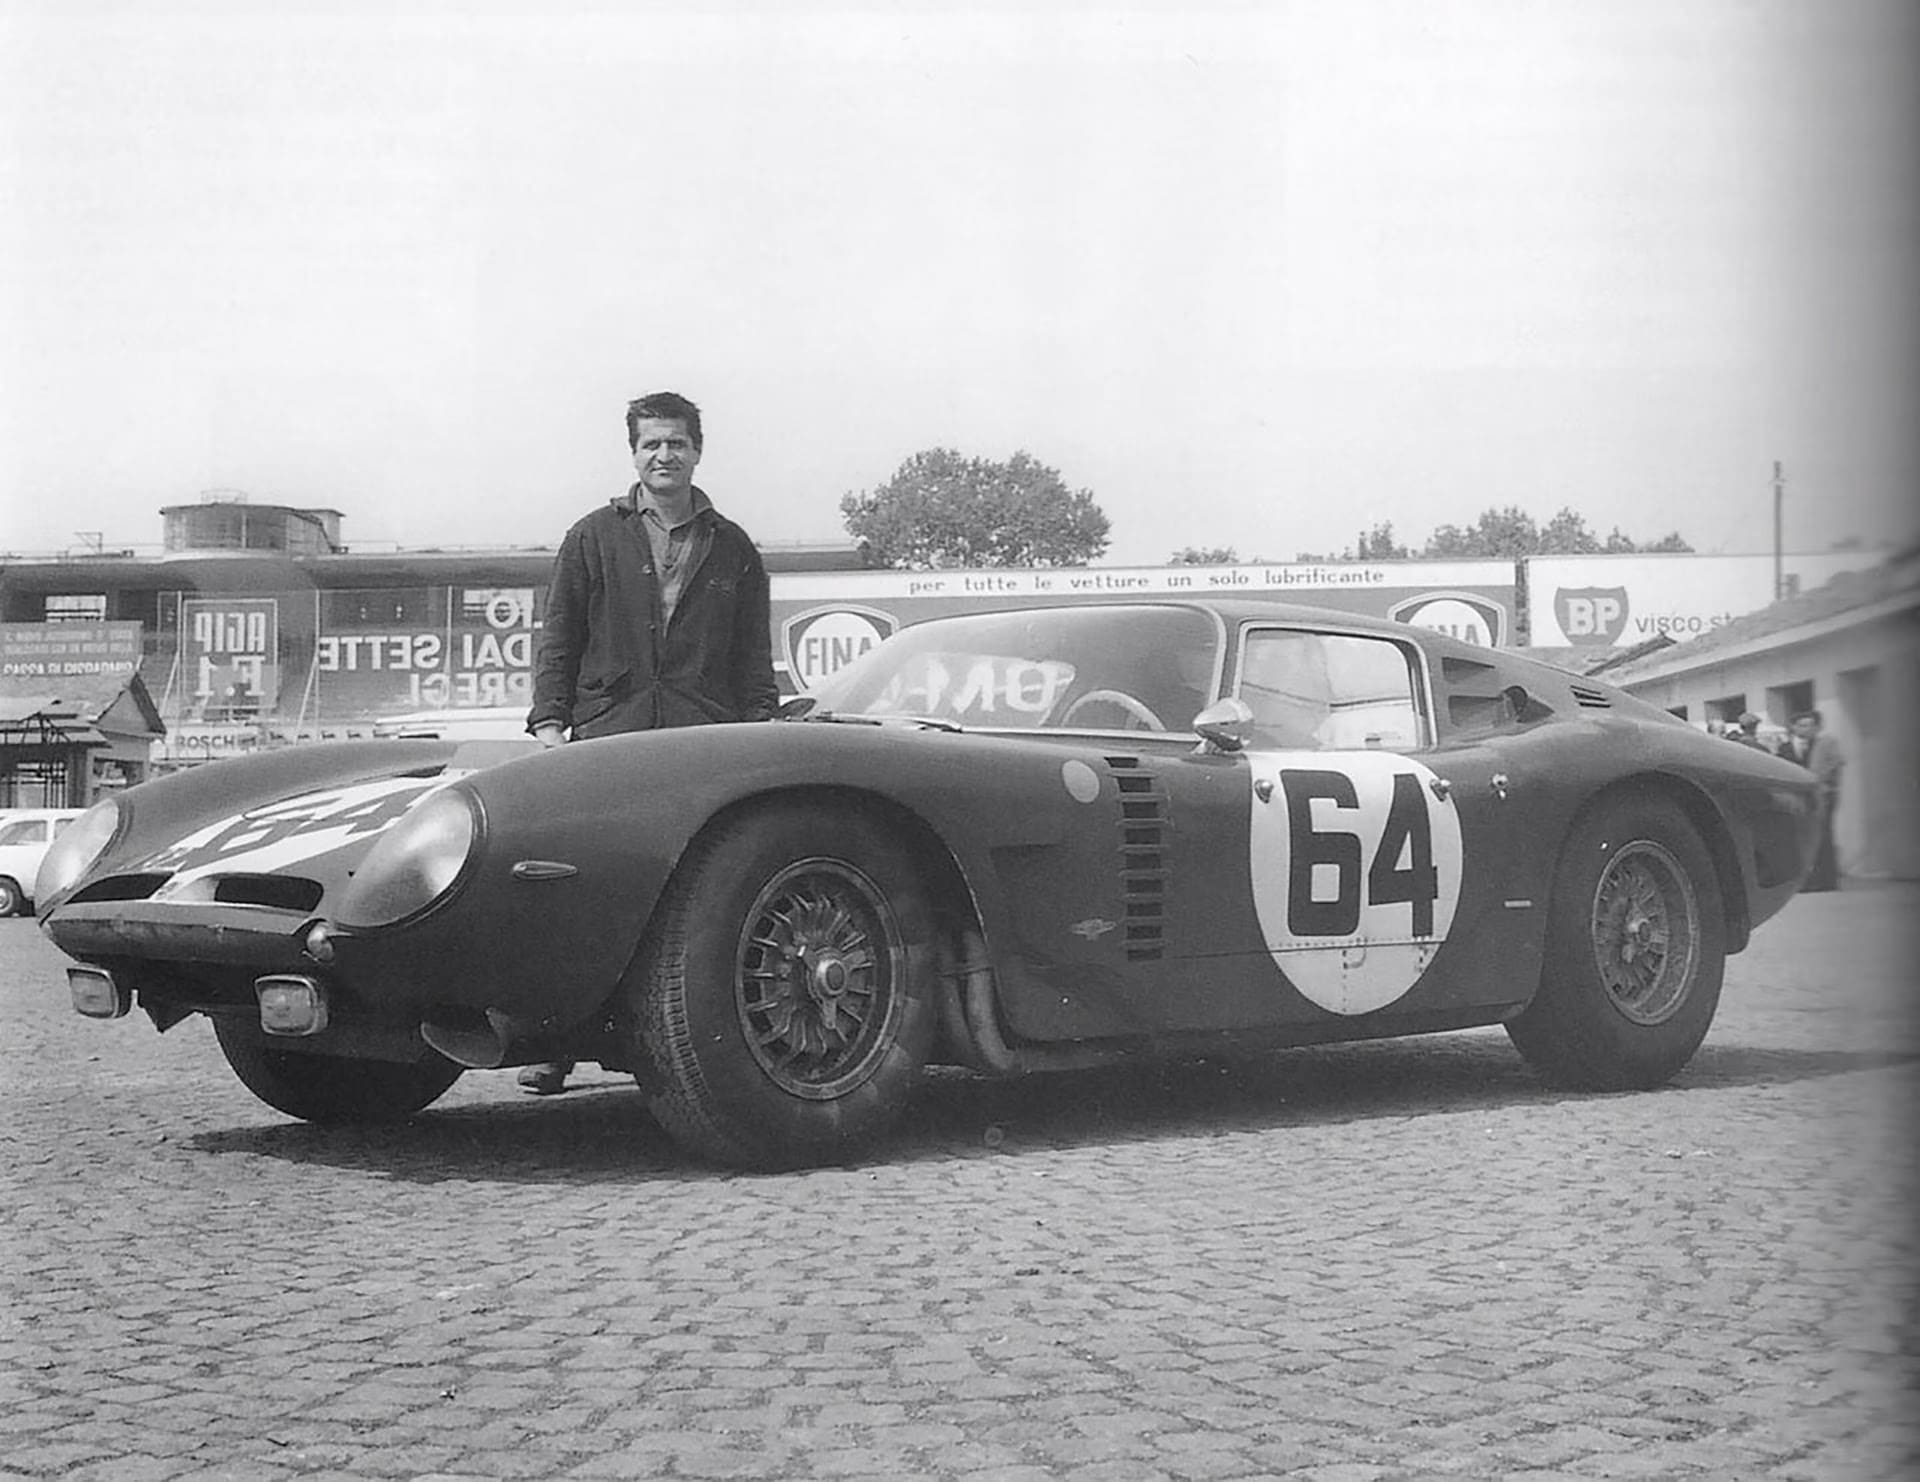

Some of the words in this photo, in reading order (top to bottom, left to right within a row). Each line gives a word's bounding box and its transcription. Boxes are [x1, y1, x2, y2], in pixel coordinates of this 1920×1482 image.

[909, 581, 945, 596] per
[965, 576, 1018, 591] tutte
[1034, 575, 1052, 589] le
[1070, 575, 1149, 589] vetture
[1167, 574, 1193, 588] un
[1209, 570, 1250, 586] solo
[1265, 567, 1384, 585] lubrificante
[1565, 597, 1622, 636] BP
[175, 734, 235, 748] BOSCH
[1279, 768, 1438, 937] 64
